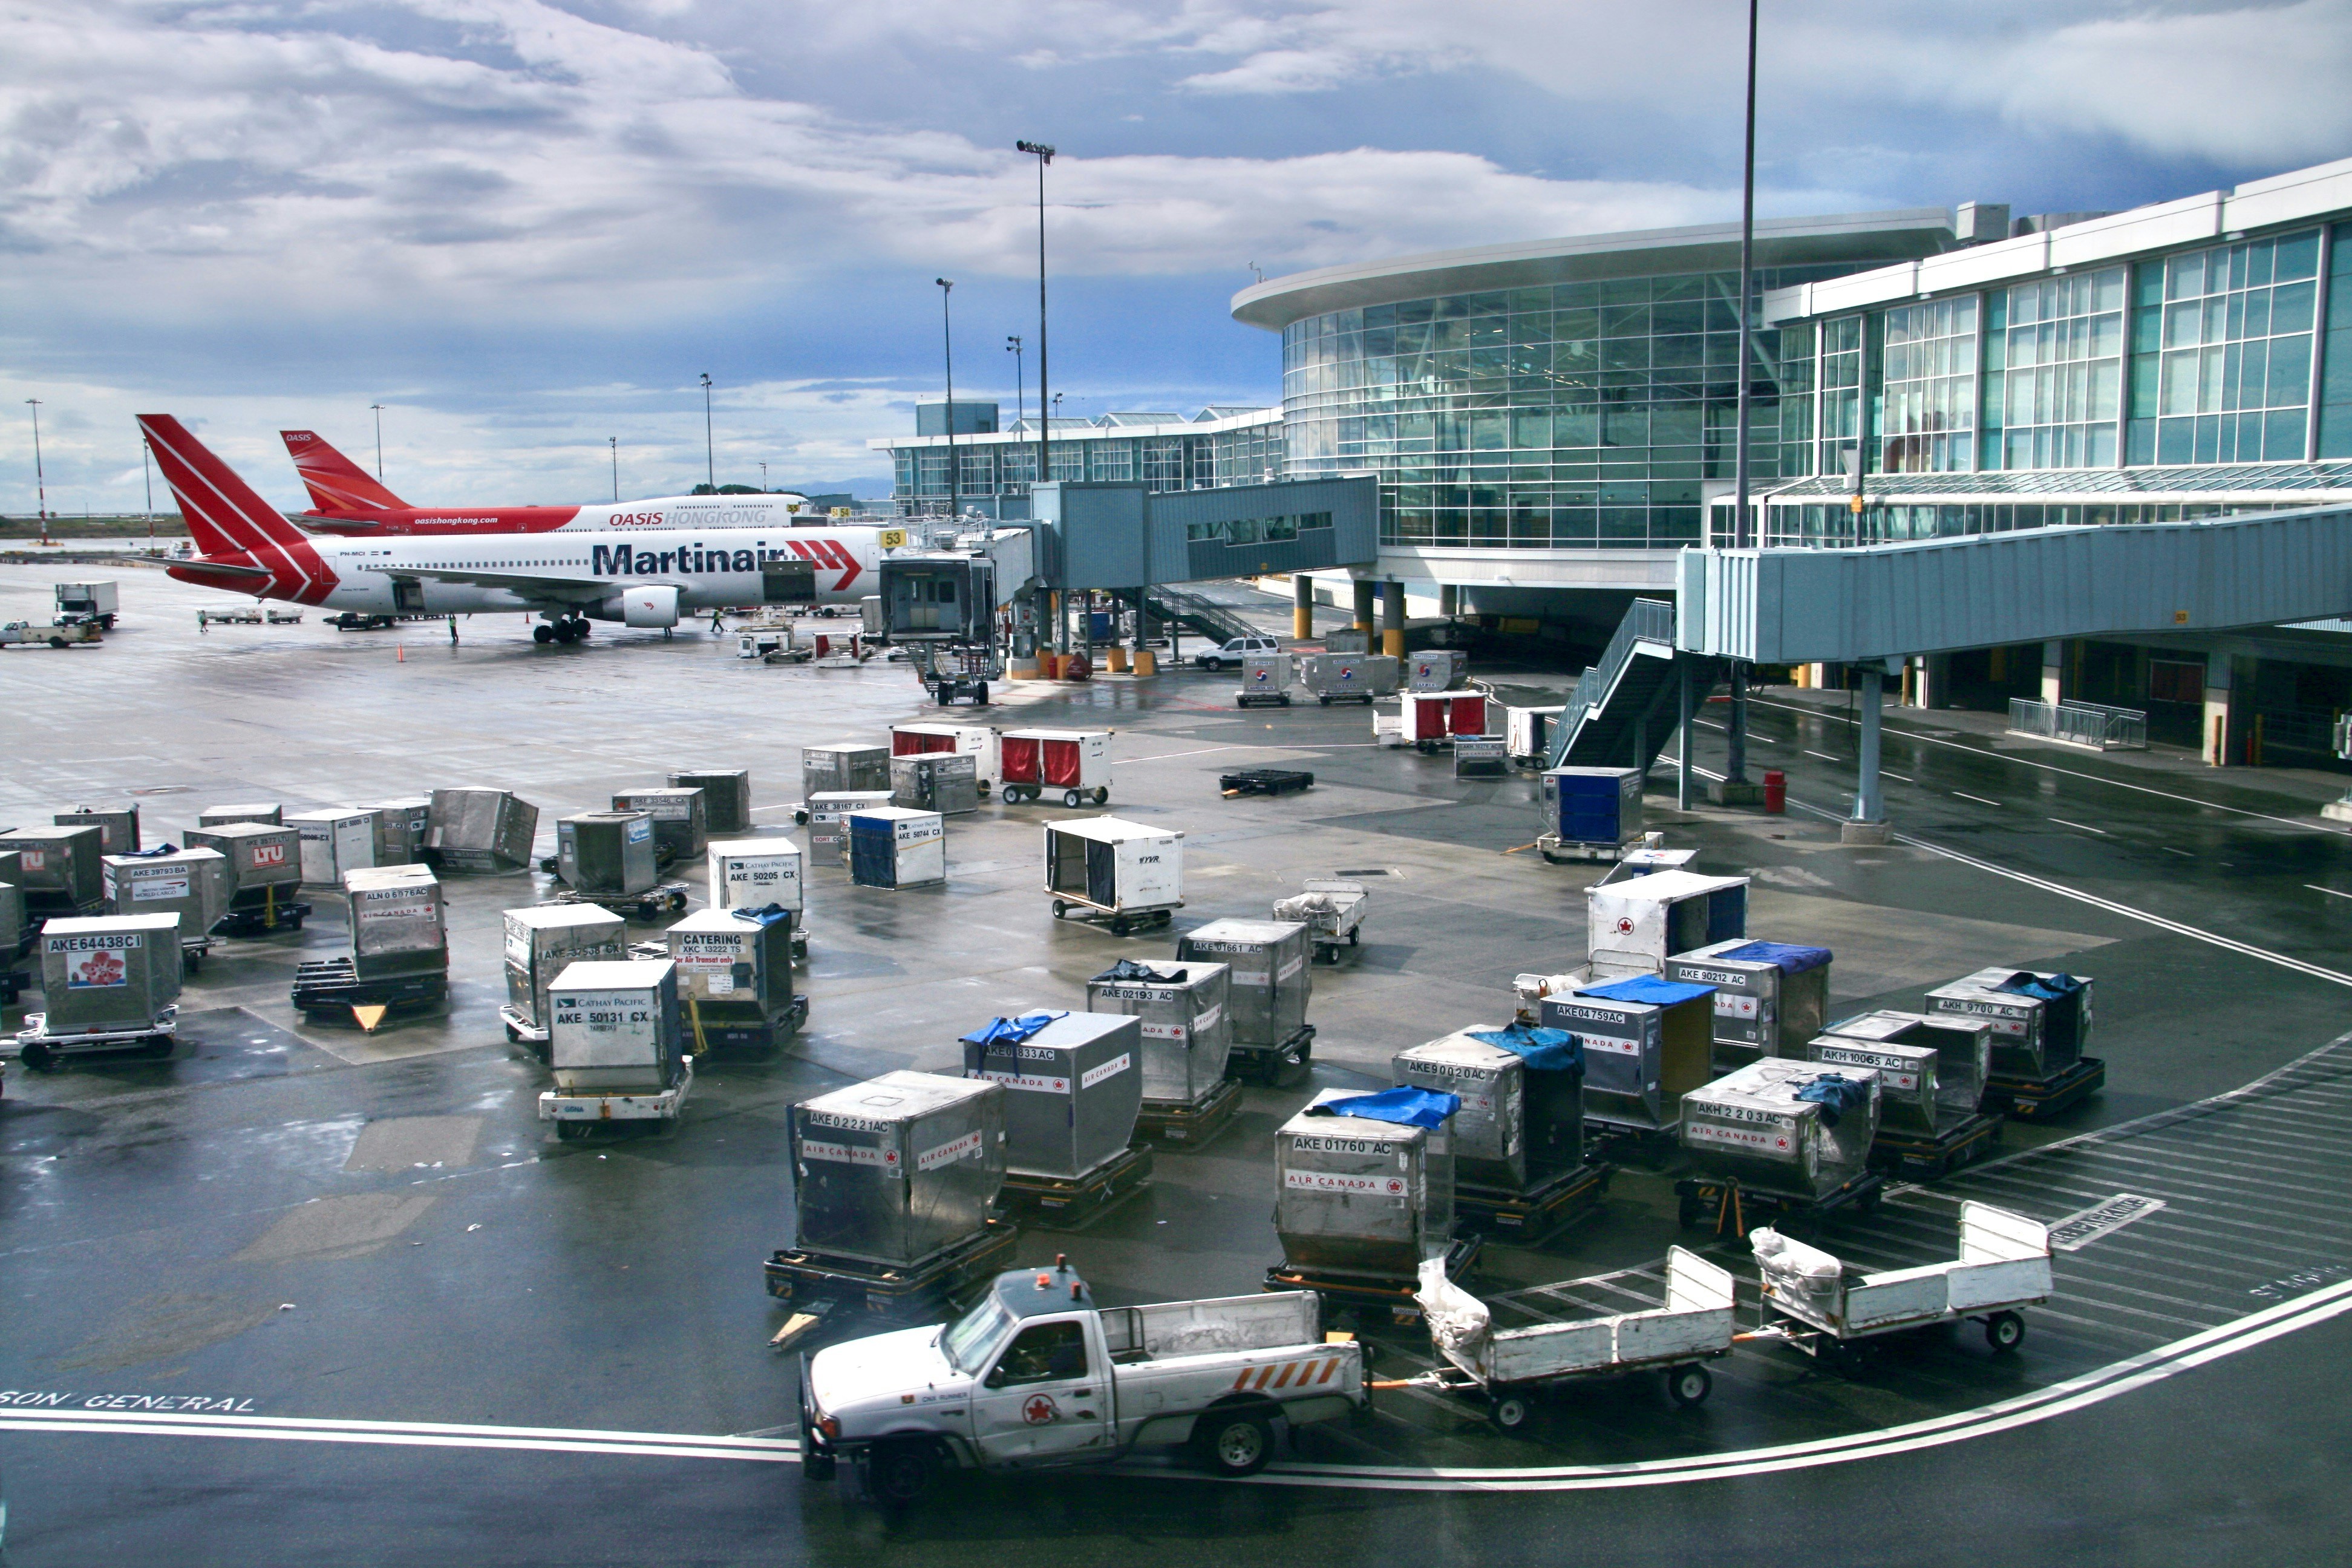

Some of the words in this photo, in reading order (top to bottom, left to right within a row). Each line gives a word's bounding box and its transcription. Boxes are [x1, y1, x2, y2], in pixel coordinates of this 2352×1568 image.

[665, 509, 766, 524] HONGKONG
[841, 508, 849, 517] 54
[415, 517, 498, 525] oasishongkong.com
[886, 532, 900, 545] 53
[593, 541, 785, 575] Martinair
[21, 852, 44, 867] TU
[255, 846, 284, 863] LTU
[731, 873, 748, 881] AKE
[754, 872, 778, 880] 50205
[684, 935, 742, 944] CATERING
[544, 949, 564, 959] AKE
[606, 944, 619, 953] CX
[1217, 944, 1243, 952] 01661
[1681, 969, 1699, 979] AKE
[1702, 972, 1726, 982] 90212
[1731, 975, 1744, 984] AC
[1102, 989, 1120, 998] AKE
[1123, 990, 1152, 1000] 02193
[1159, 991, 1172, 1000] AC
[578, 999, 613, 1007] CATHAY
[1942, 1001, 1961, 1010] AKH
[1967, 1003, 1993, 1014] 9700
[1999, 1007, 2013, 1016] AC
[557, 1013, 582, 1024] AKE
[590, 1012, 624, 1022] 50131
[630, 1011, 648, 1022] CX
[1584, 1038, 1613, 1047] NADA
[1824, 1050, 1846, 1060] AKH
[1850, 1053, 1880, 1065] 10065
[1884, 1058, 1900, 1068] AC
[1085, 1075, 1094, 1083] AIR
[1096, 1063, 1118, 1077] CANADA
[998, 1076, 1043, 1086] CANADA
[1698, 1103, 1721, 1115] AKH
[811, 1114, 832, 1125] AKE
[1717, 1130, 1766, 1143] CANADA
[806, 1145, 824, 1154] AIR
[829, 1148, 875, 1159] CANADA
[921, 1154, 935, 1164] AIR
[938, 1140, 968, 1158] CANADA
[1295, 1137, 1321, 1149] AKE
[1325, 1139, 1365, 1152] 01760
[1373, 1143, 1391, 1154] AC
[1289, 1175, 1312, 1184] AIR
[1318, 1177, 1376, 1189] CANADA
[2068, 1197, 2151, 1233] PARKING
[85, 1394, 255, 1412] GENERAL
